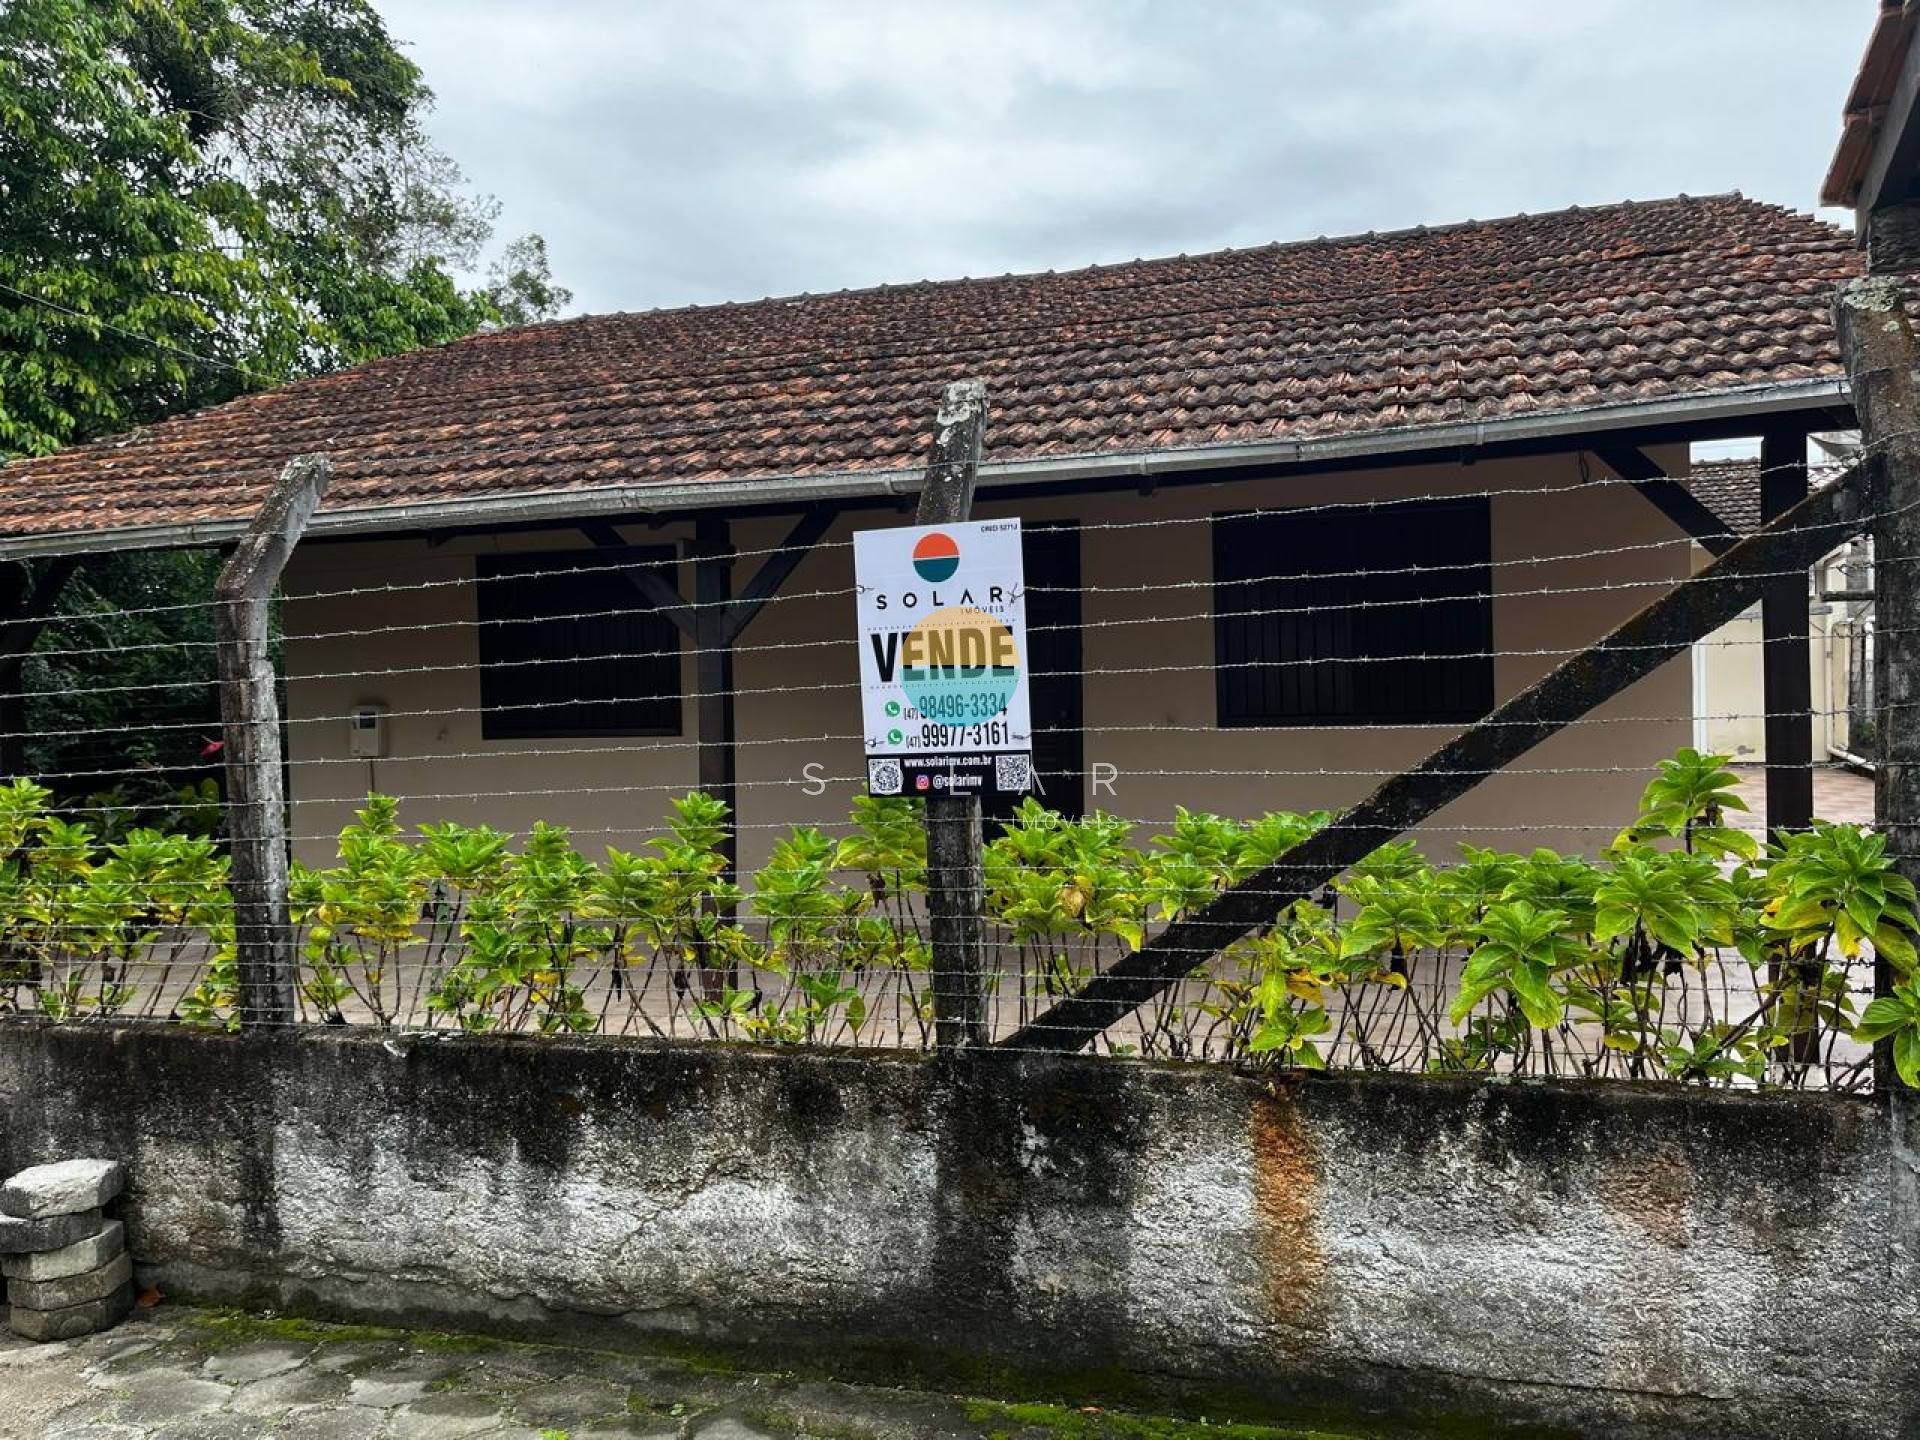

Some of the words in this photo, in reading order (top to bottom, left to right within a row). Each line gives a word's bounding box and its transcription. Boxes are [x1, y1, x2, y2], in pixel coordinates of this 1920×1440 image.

[876, 586, 1003, 609] SOLAR
[870, 626, 1015, 683] VENDE
[919, 692, 1008, 719] 98496-3334
[922, 721, 1009, 748] 99977-3161
[903, 754, 992, 767] www.solarimv.com.br
[932, 774, 983, 790] @solarimv
